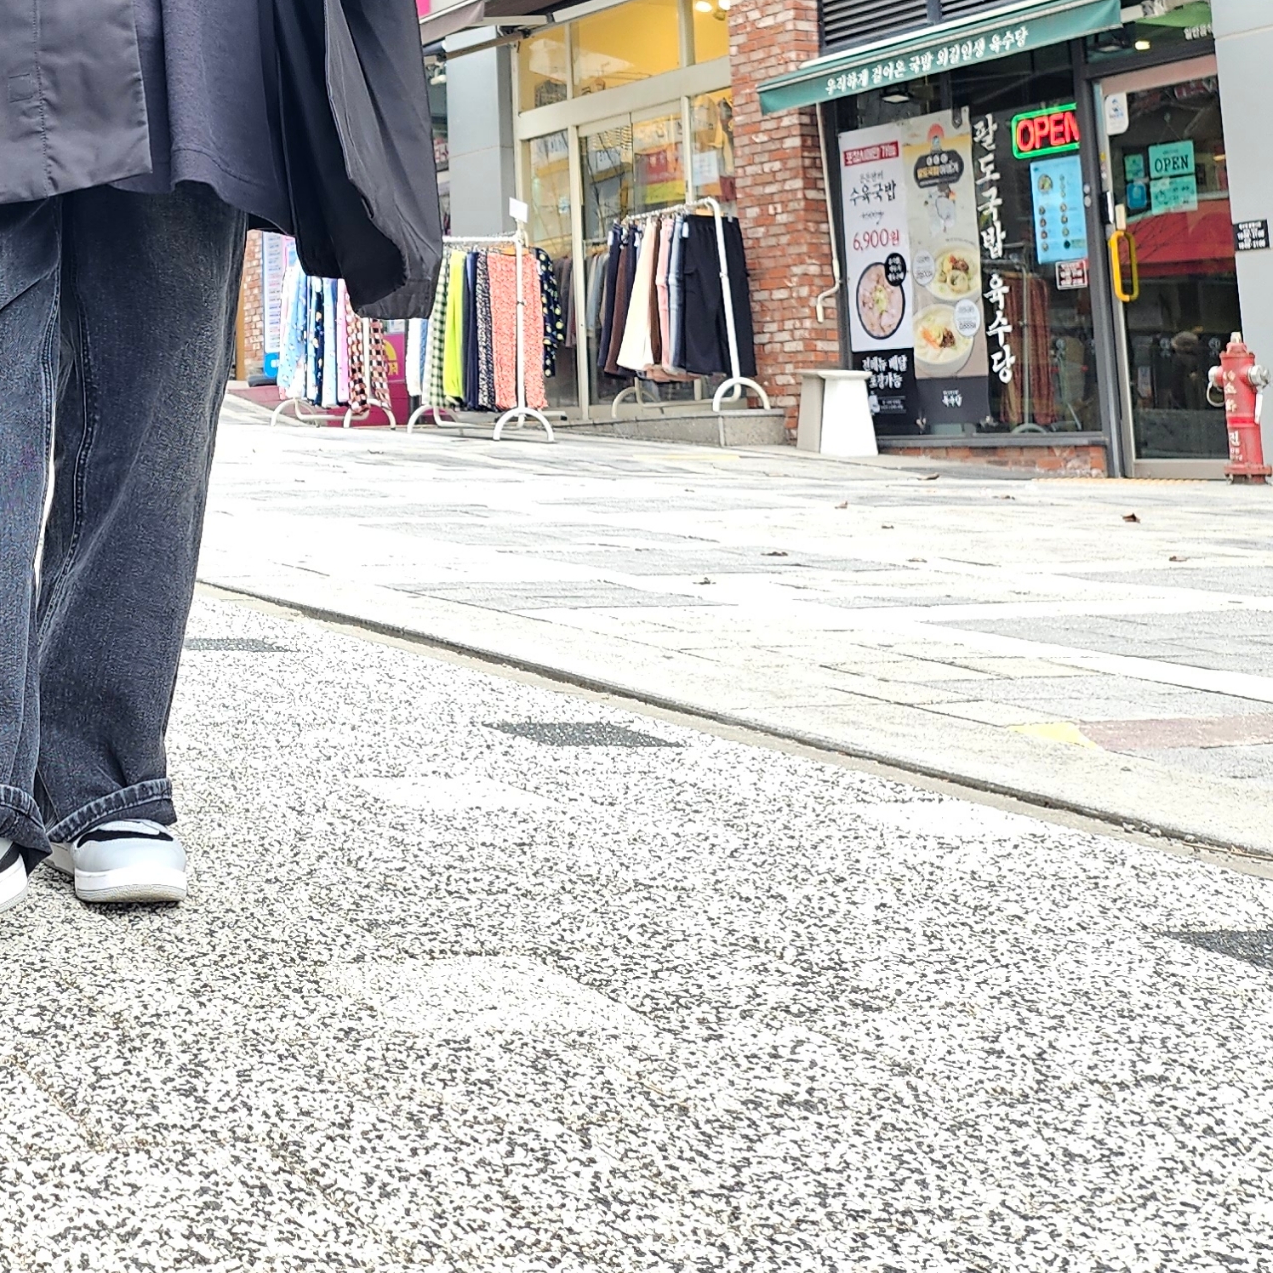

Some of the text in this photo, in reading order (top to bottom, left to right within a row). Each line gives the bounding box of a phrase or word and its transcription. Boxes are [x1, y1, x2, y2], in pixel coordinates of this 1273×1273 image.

[826, 68, 869, 96] 우직하게
[909, 50, 934, 74] 국밥
[988, 26, 1028, 53] 육수당
[1016, 111, 1080, 152] OPEN
[1154, 154, 1189, 174] OPEN
[849, 179, 897, 206] 수육국밥
[853, 228, 900, 252] 6,900원
[974, 113, 1016, 384] 팔도국밥 육수당
